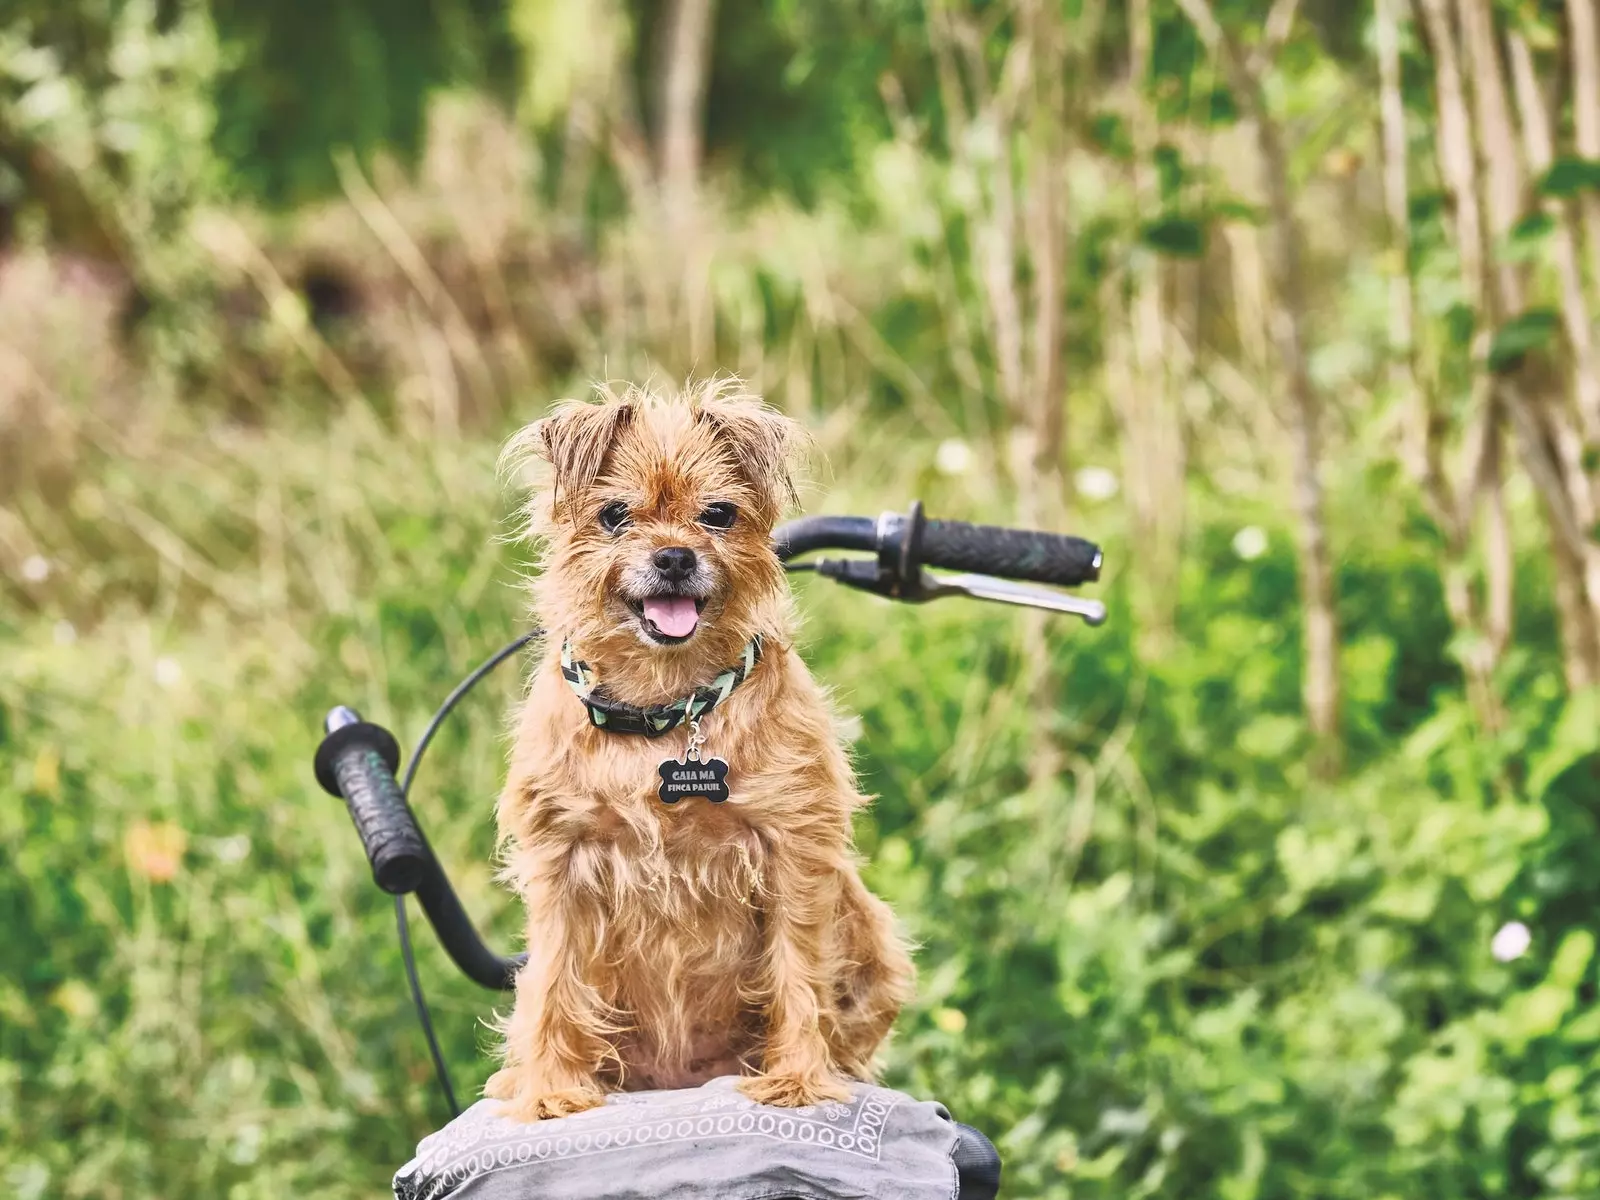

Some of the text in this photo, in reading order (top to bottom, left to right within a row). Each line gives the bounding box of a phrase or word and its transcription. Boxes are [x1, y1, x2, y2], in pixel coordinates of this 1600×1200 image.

[672, 770, 716, 780] GAIA MA
[667, 783, 721, 792] FINCA PAJUIL
